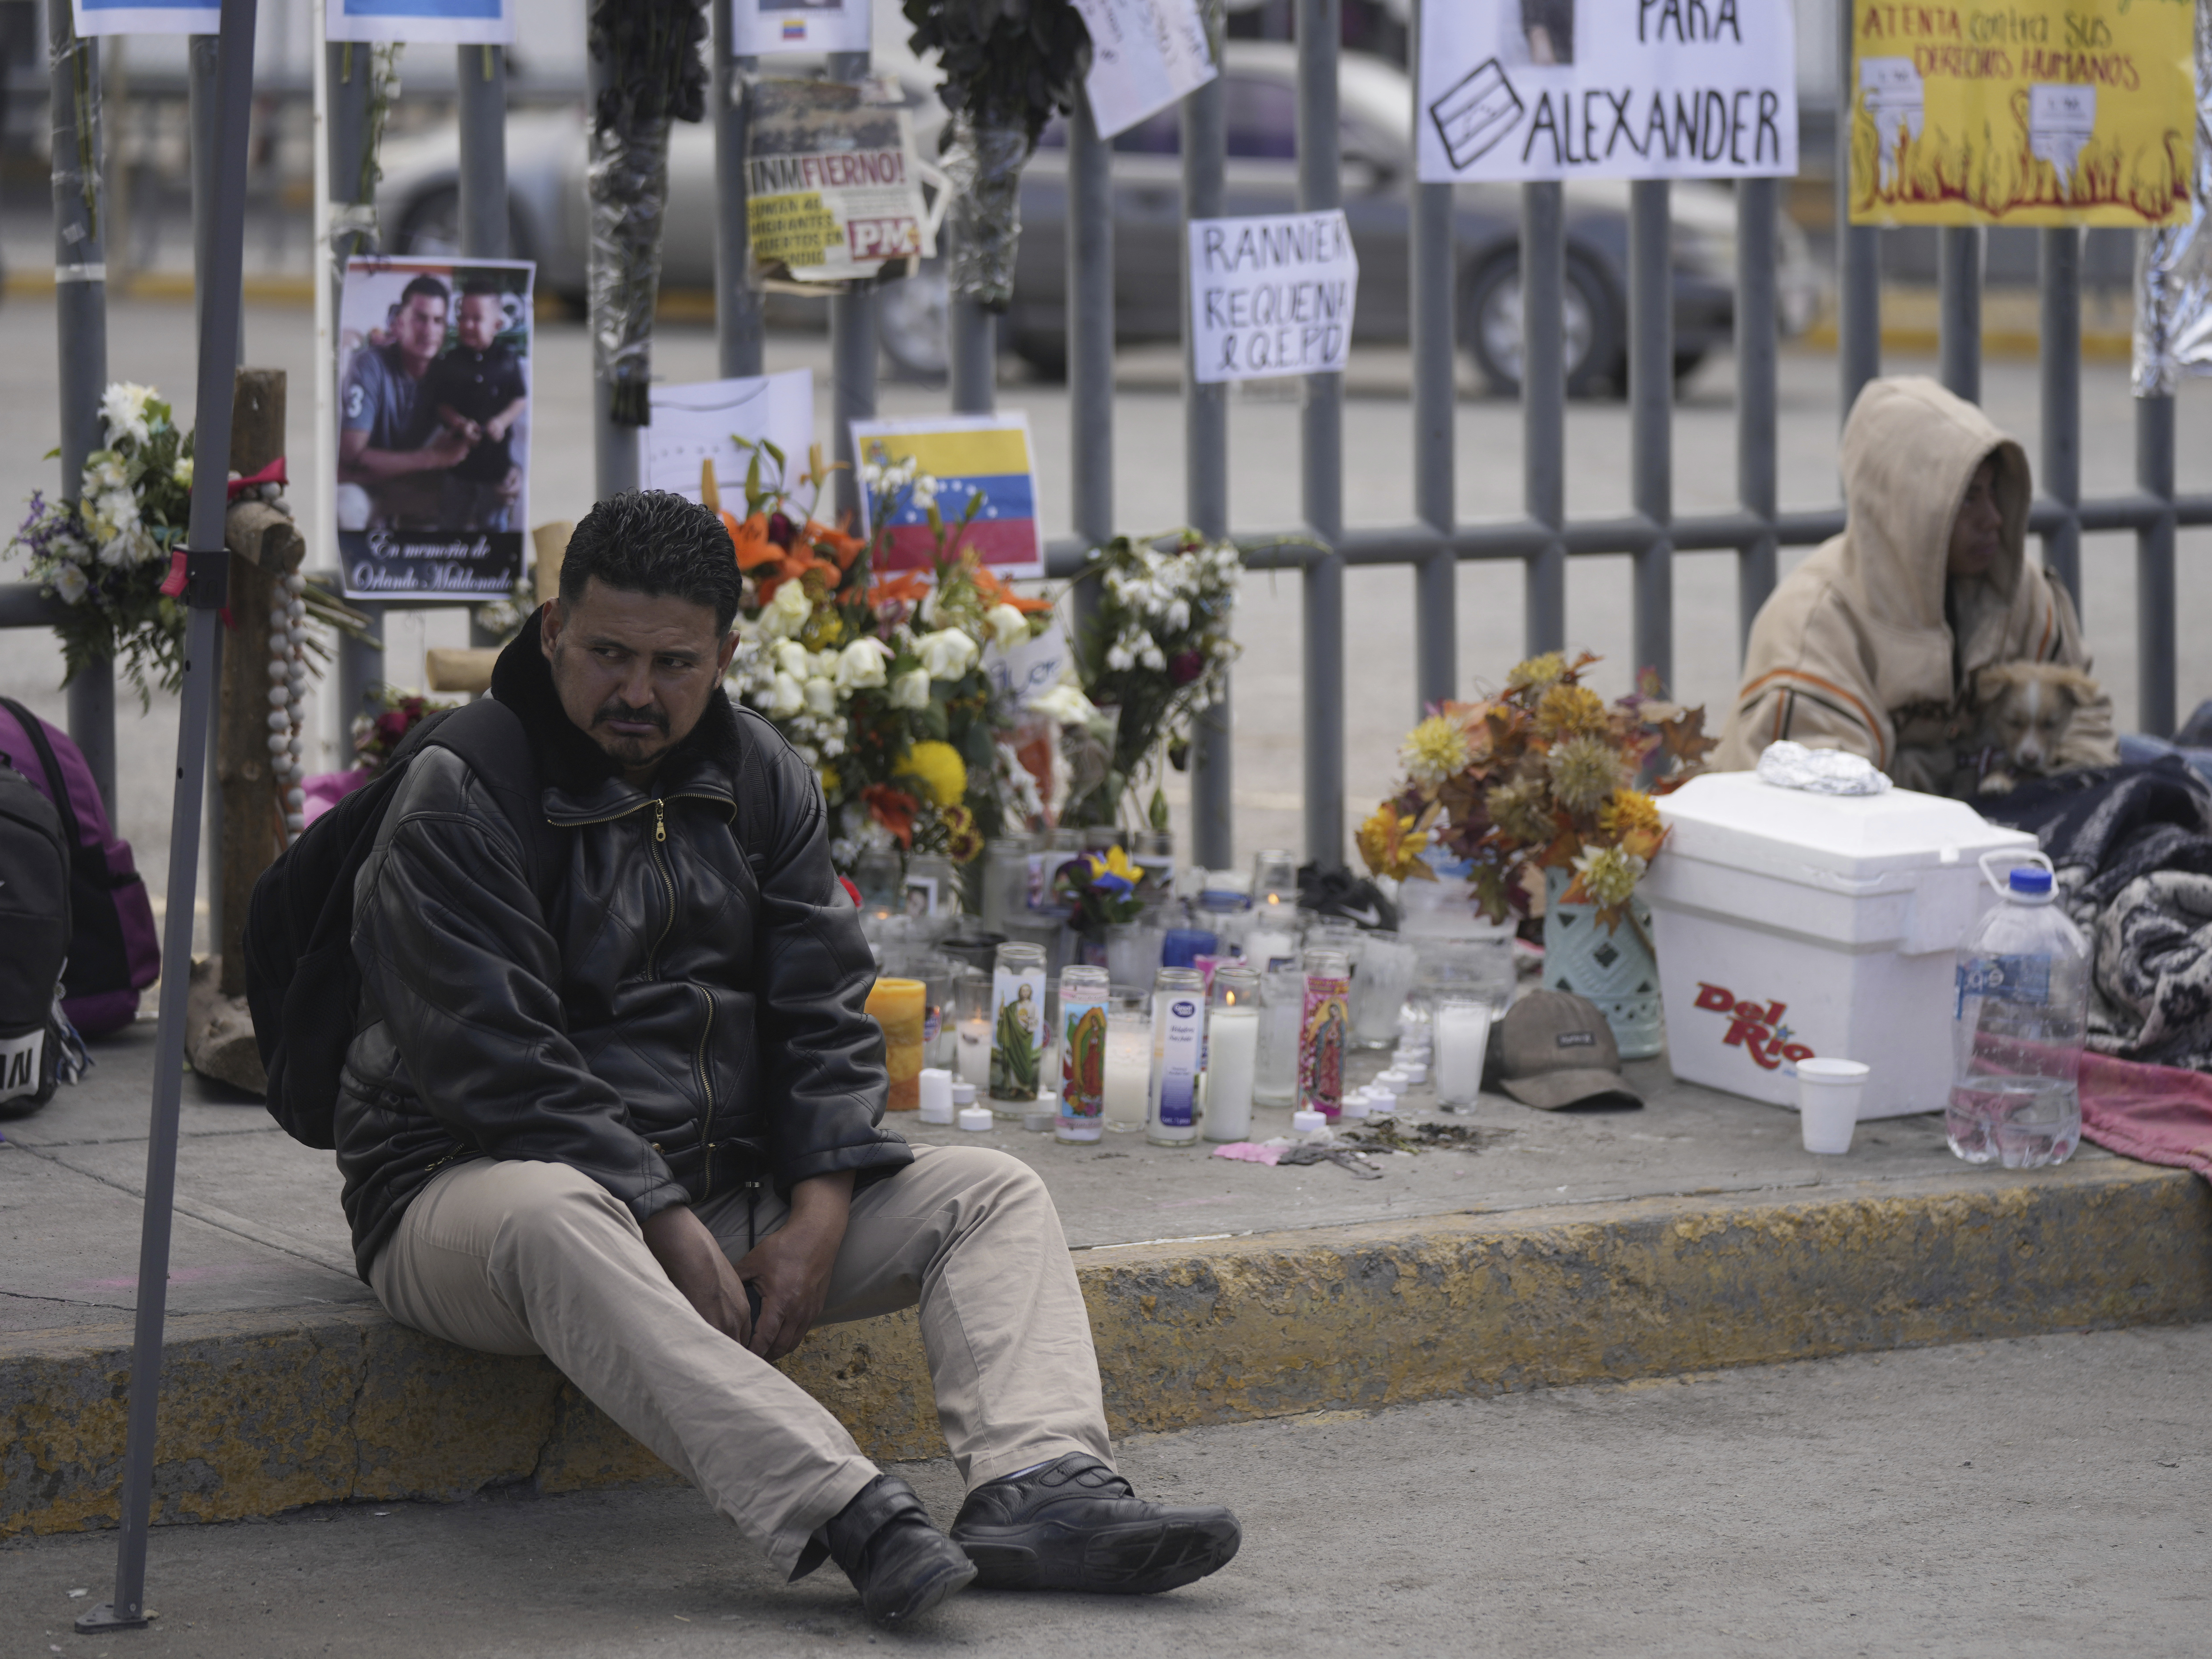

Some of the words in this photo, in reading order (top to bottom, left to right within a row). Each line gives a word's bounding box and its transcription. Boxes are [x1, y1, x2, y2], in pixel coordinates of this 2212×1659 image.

[1863, 5, 1962, 41] ATENTA
[1914, 43, 2014, 81] DERECHOS
[2021, 44, 2141, 92] HUMANOS
[1522, 88, 1781, 165] ALEXANDER
[853, 223, 915, 256] PM
[367, 530, 399, 561] En
[403, 538, 469, 559] memoria
[470, 535, 491, 558] de
[354, 560, 419, 592] Orlando
[422, 560, 513, 592] Maldonado
[1693, 981, 1787, 1026] Del
[1722, 1015, 1815, 1071] Rio
